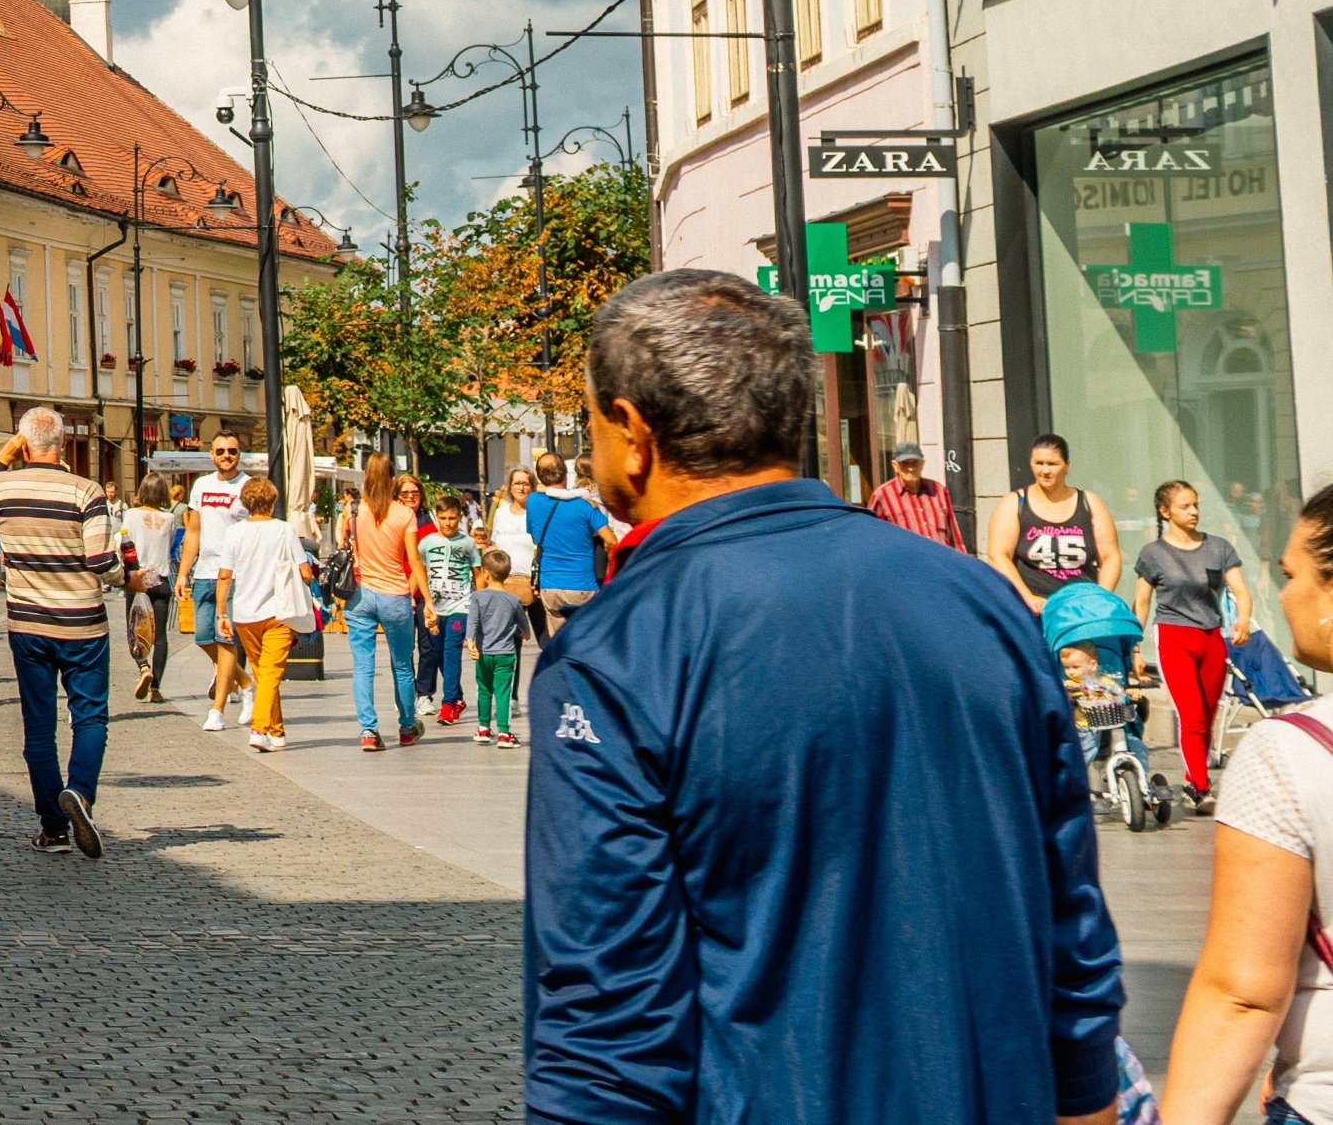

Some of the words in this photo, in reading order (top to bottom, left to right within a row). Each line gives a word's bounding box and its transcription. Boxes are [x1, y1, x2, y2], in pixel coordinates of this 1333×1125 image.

[821, 151, 947, 173] ZARA
[769, 269, 885, 288] Fmacia
[1028, 534, 1087, 569] 45
